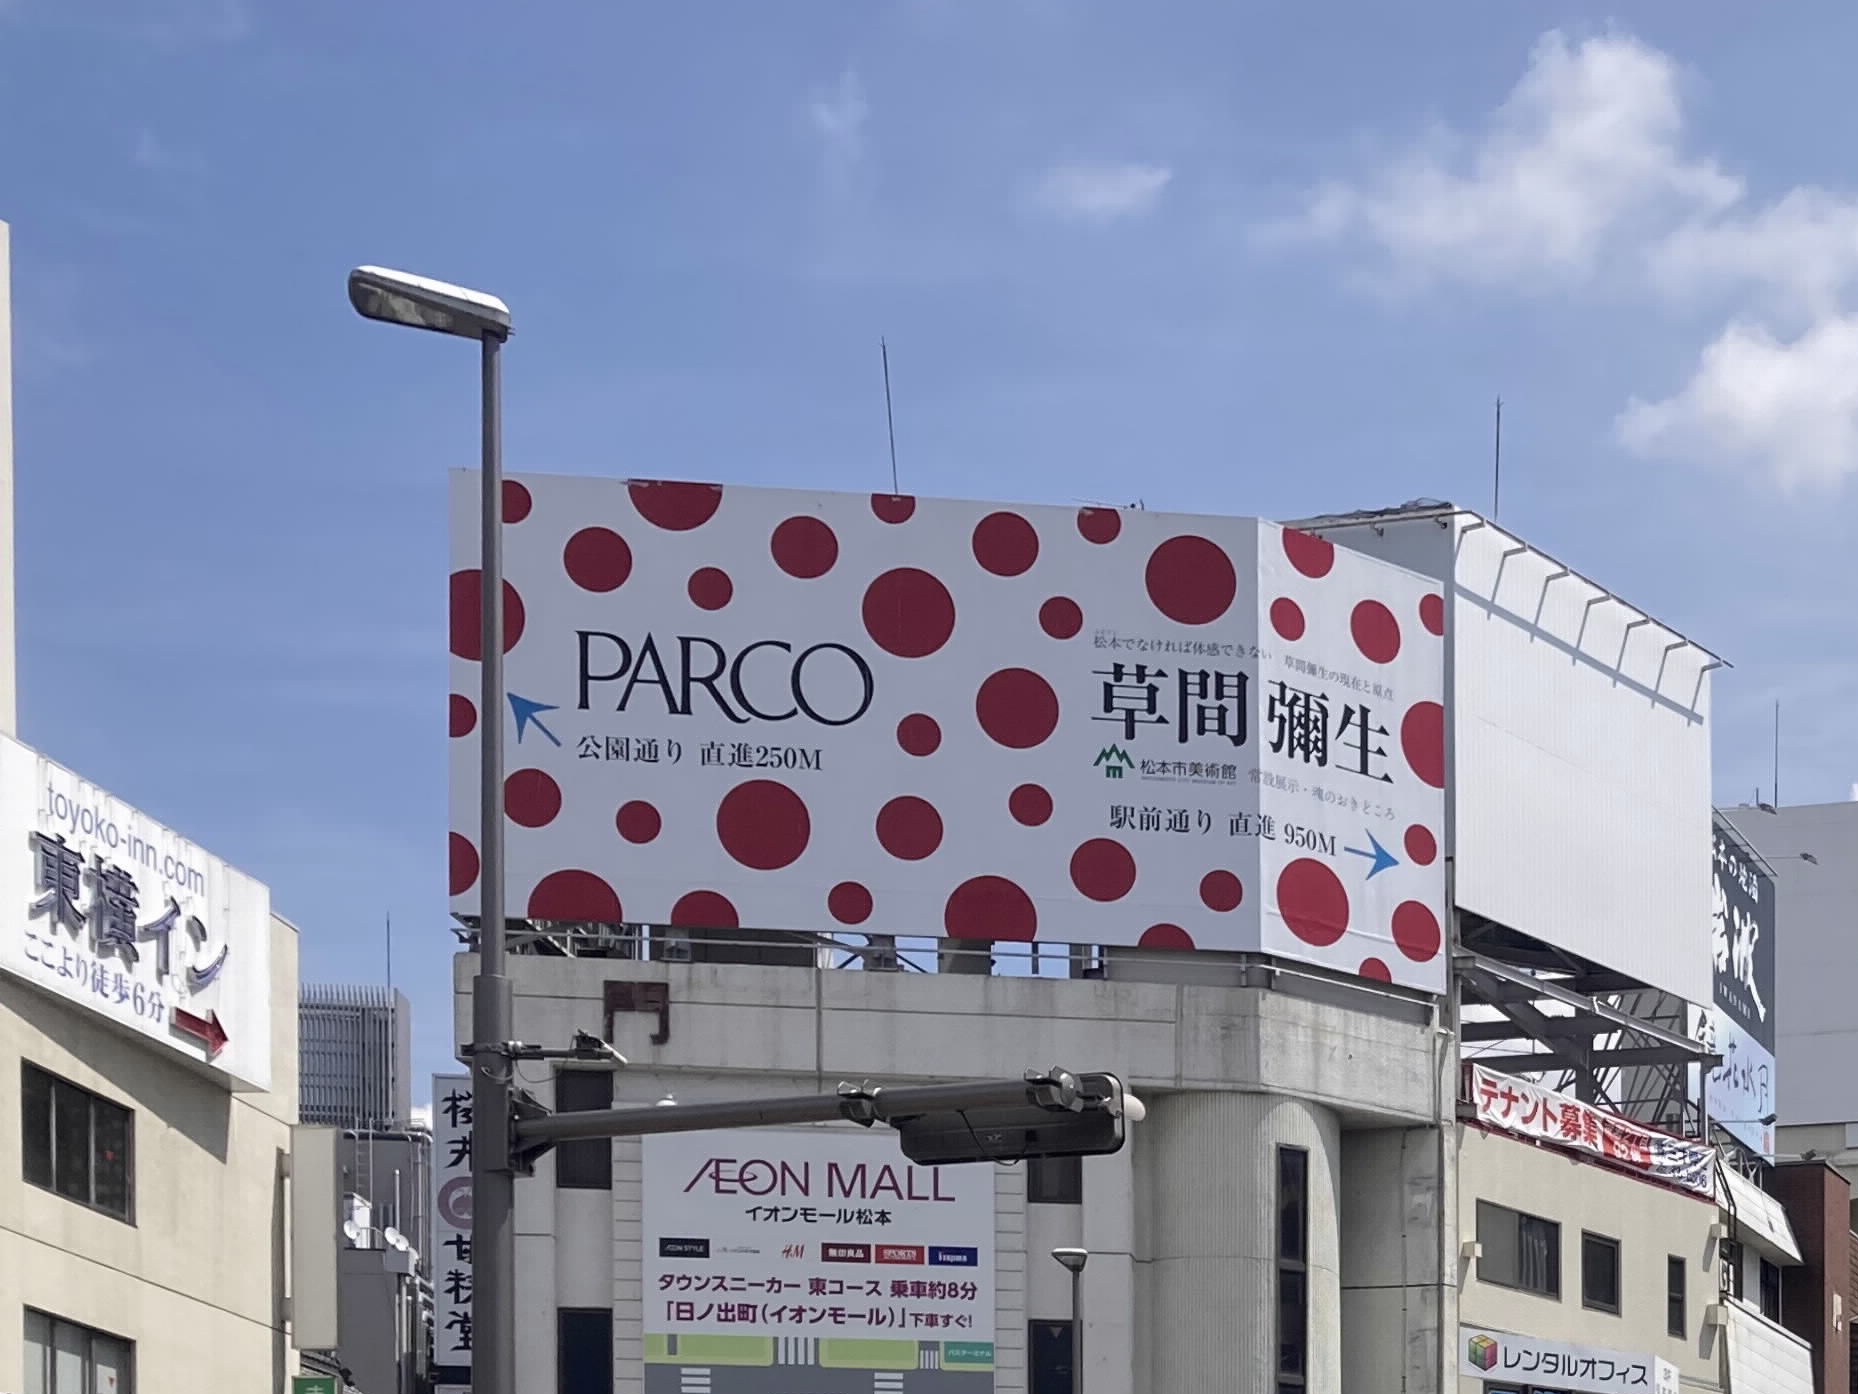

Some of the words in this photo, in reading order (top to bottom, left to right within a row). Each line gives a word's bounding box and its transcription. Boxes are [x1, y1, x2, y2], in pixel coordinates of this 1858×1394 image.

[1093, 633, 1272, 661] 松本でなければ体感できない
[576, 630, 875, 726] PARCO
[1090, 661, 1395, 785] 草間彌生
[577, 734, 682, 766] 公園通り
[700, 742, 824, 772] 直進250M
[1140, 758, 1238, 780] 松本市美術館
[47, 781, 206, 898] toyoko-inn.com
[1110, 804, 1212, 835] 駅前通り
[1229, 811, 1276, 841] 直進
[1283, 823, 1338, 857] 950M
[23, 930, 166, 1025] ここより徒歩6分
[1479, 1078, 1600, 1149] テナント募集
[827, 1162, 956, 1202] MALL
[744, 1206, 893, 1226] イオンモール松本
[658, 1274, 801, 1292] タウンスニーカー
[808, 1276, 883, 1297] 東コース
[890, 1280, 978, 1301] 乗車約8分
[909, 1311, 974, 1329] 下車すぐ!
[1503, 1345, 1649, 1386] レンタルオフィス
